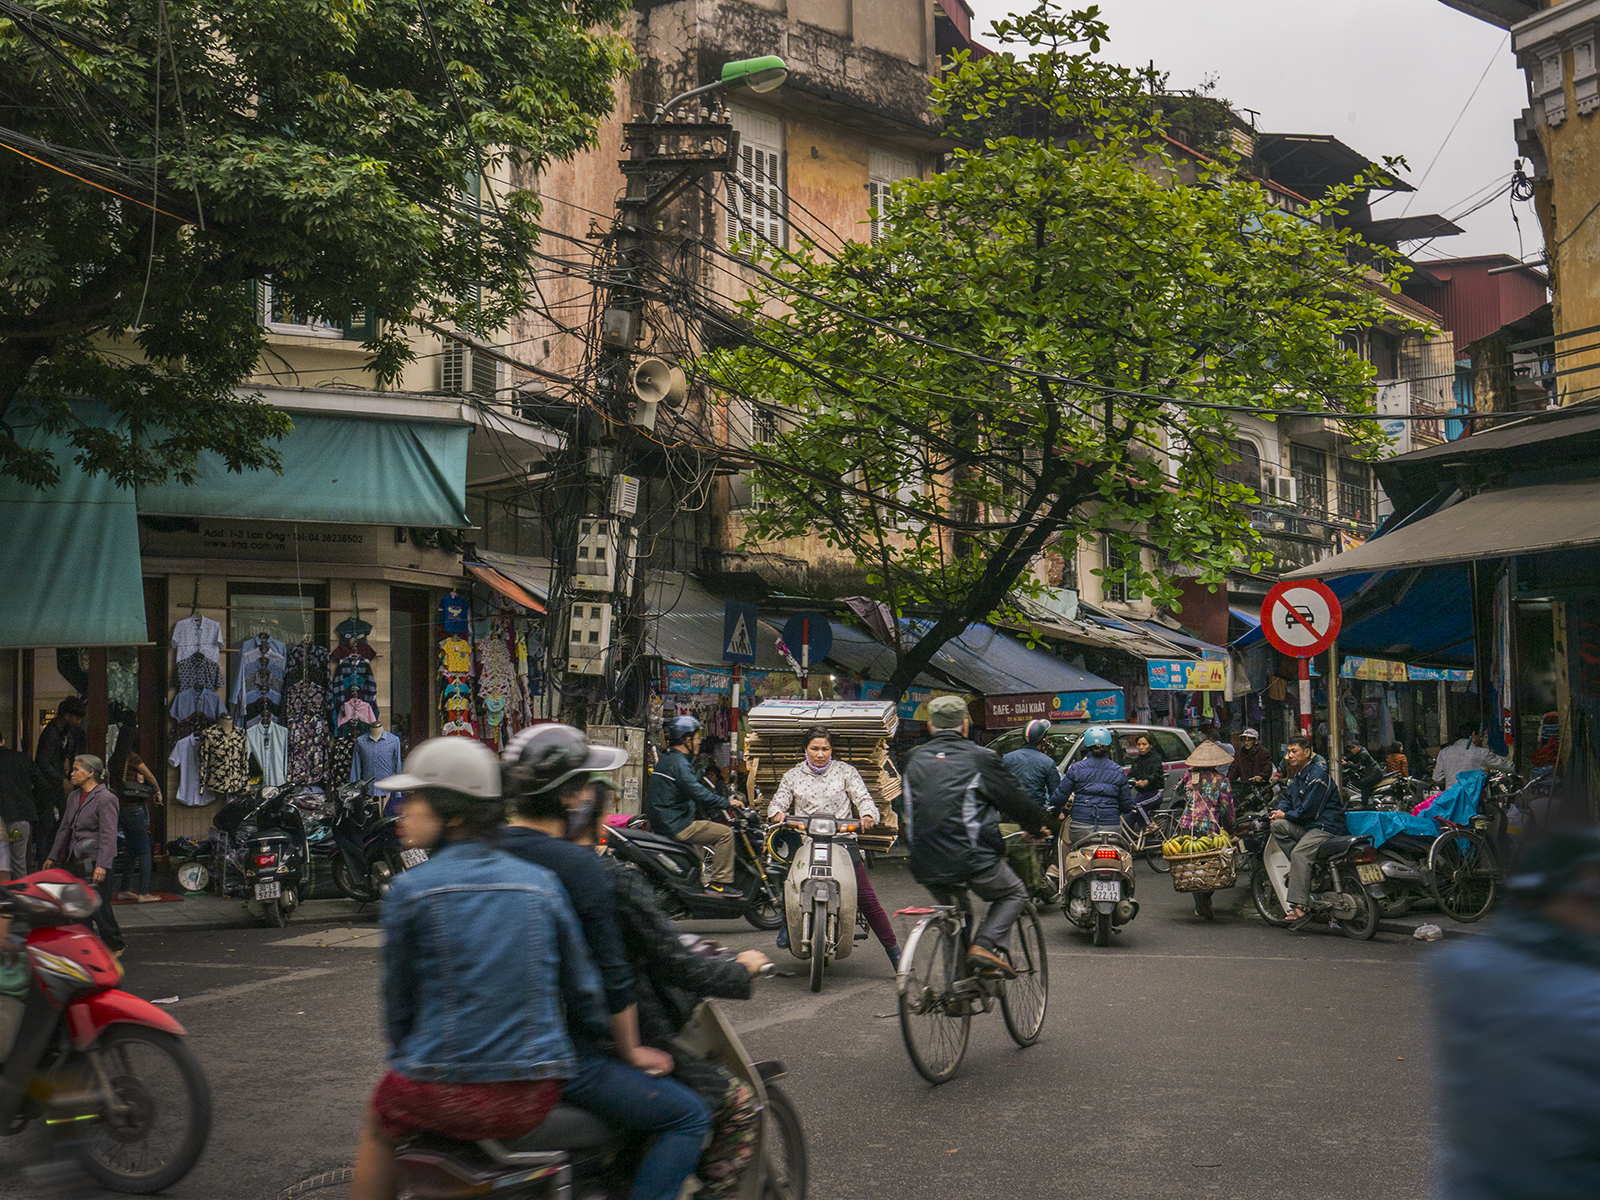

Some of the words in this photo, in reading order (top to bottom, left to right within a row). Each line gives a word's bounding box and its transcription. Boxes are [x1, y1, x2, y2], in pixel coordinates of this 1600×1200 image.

[229, 530, 243, 538] 1-3
[247, 531, 263, 539] Lan
[266, 531, 286, 542] Ong
[992, 704, 1010, 715] CAFE
[1015, 699, 1028, 713] GIẢI
[1029, 701, 1045, 713] KHÁT
[1093, 891, 1118, 900] 522.12
